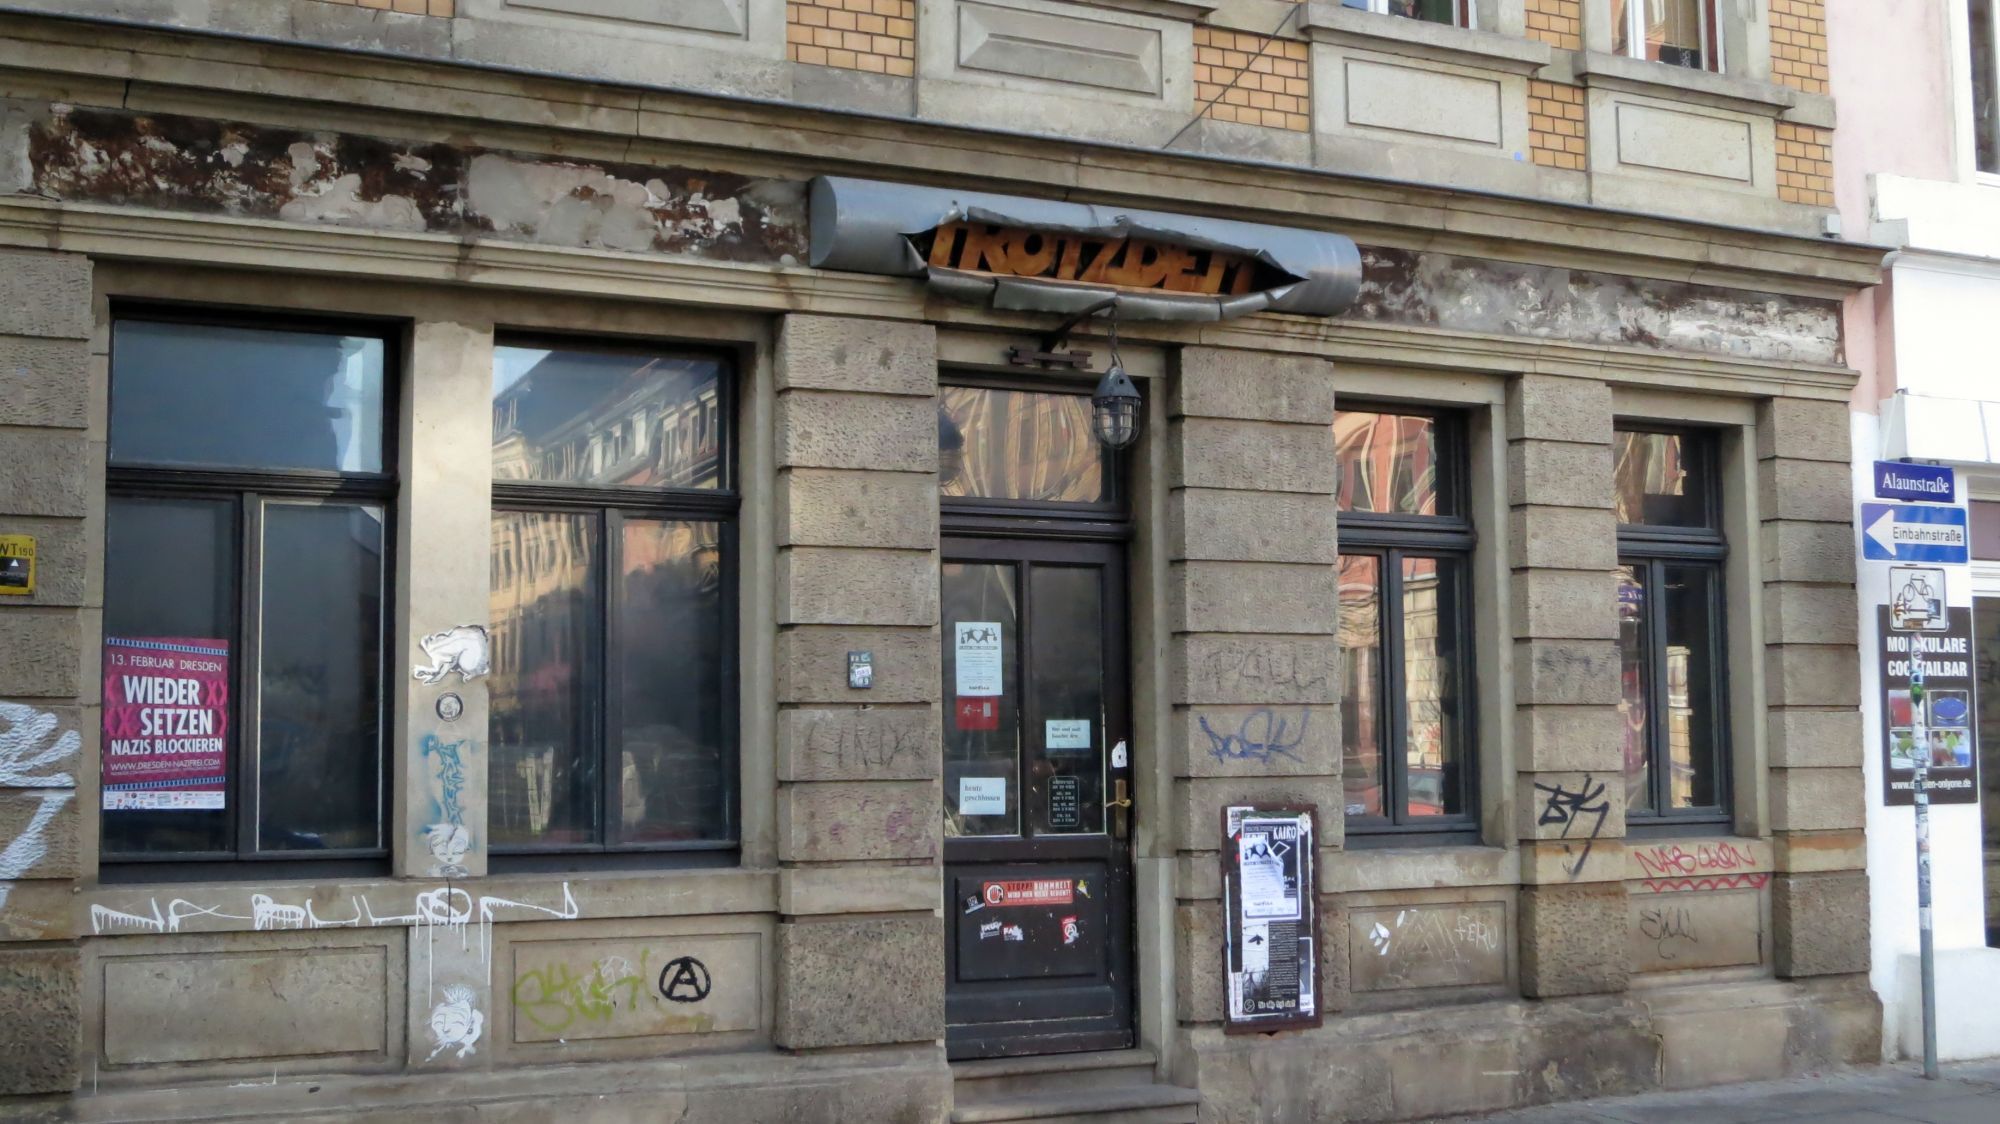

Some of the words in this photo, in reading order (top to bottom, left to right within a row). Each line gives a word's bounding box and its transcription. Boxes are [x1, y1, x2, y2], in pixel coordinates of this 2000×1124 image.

[1882, 472, 1950, 494] Alaunstraße
[1892, 525, 1962, 543] Einbahnstraße
[111, 653, 128, 667] 13.
[130, 655, 175, 669] FEBRUAR
[180, 659, 222, 672] DRESDEN
[1887, 660, 1968, 677] COCTAILBAR
[123, 674, 200, 706] WIEDER
[140, 706, 213, 736] SETZEN
[111, 739, 152, 756] NAZIS
[154, 737, 223, 754] BLOCKIEREN
[1273, 825, 1297, 841] KAIRO
